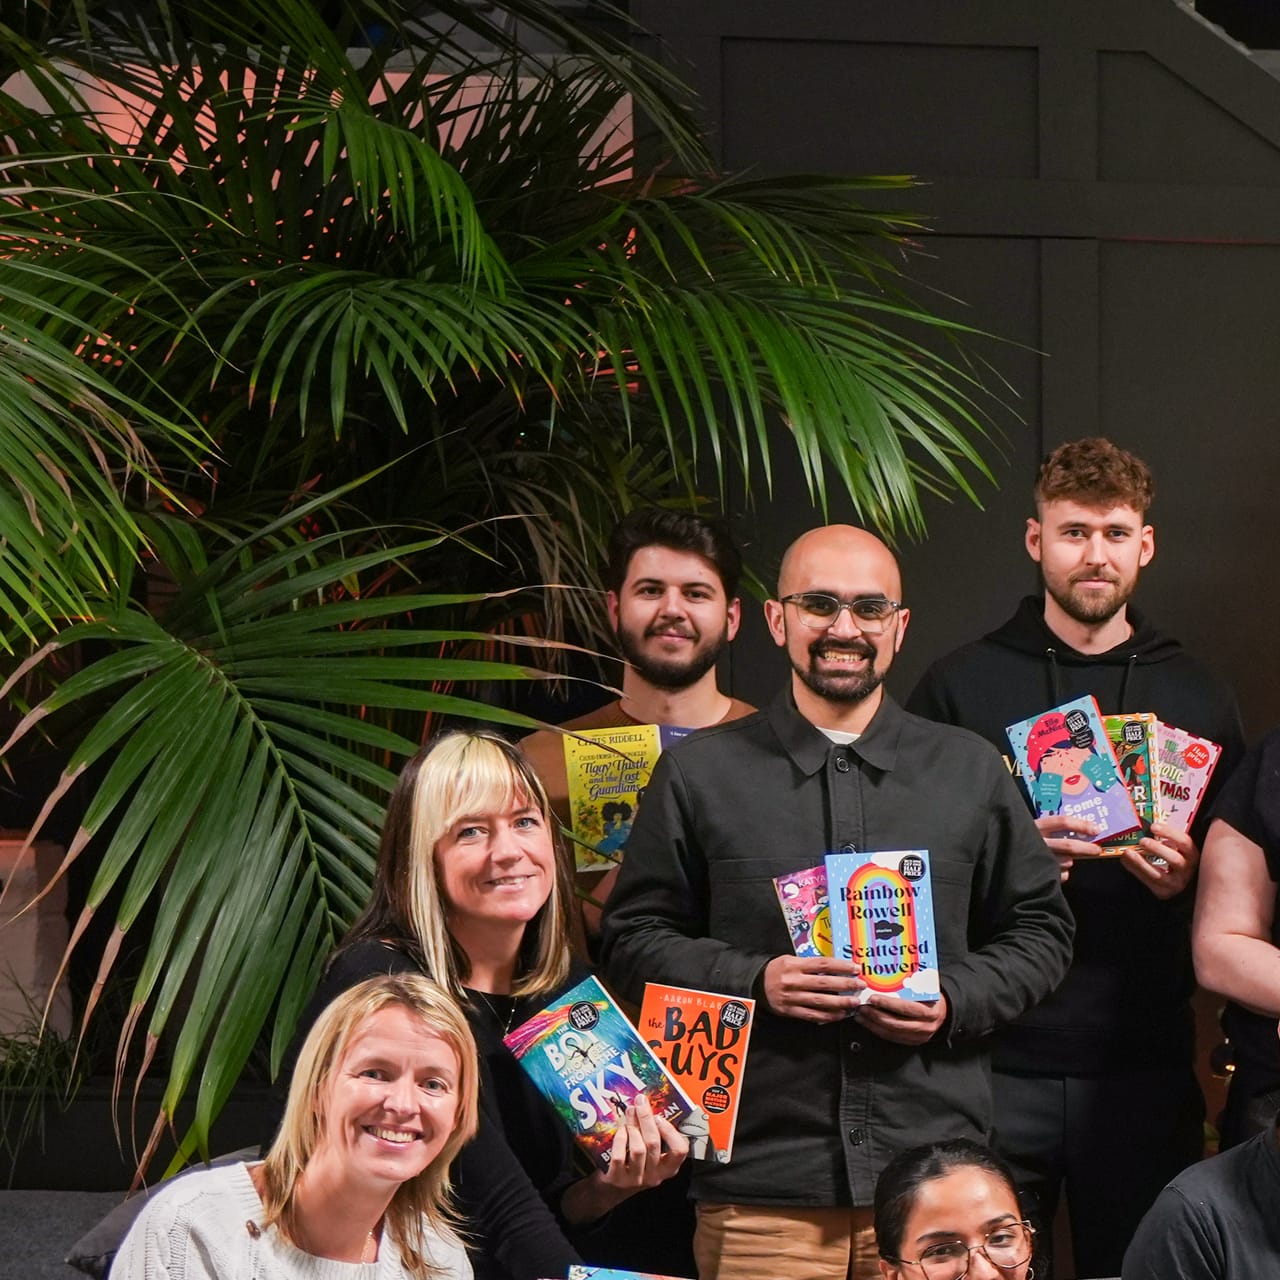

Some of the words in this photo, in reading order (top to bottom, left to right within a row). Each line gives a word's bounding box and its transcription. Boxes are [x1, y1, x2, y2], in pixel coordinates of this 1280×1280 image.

[609, 734, 645, 744] RIDDELL
[613, 757, 649, 771] Thistle
[618, 772, 640, 783] Lost
[589, 782, 640, 801] Guardians
[1064, 798, 1103, 816] Some
[840, 885, 921, 901] Rainbow
[850, 903, 912, 920] Rowell
[842, 941, 929, 959] Scattered
[862, 961, 927, 975] howers
[648, 1017, 665, 1029] the
[664, 1006, 741, 1050] BAD
[648, 1039, 738, 1088] GUYS
[569, 1051, 648, 1130] SKY
